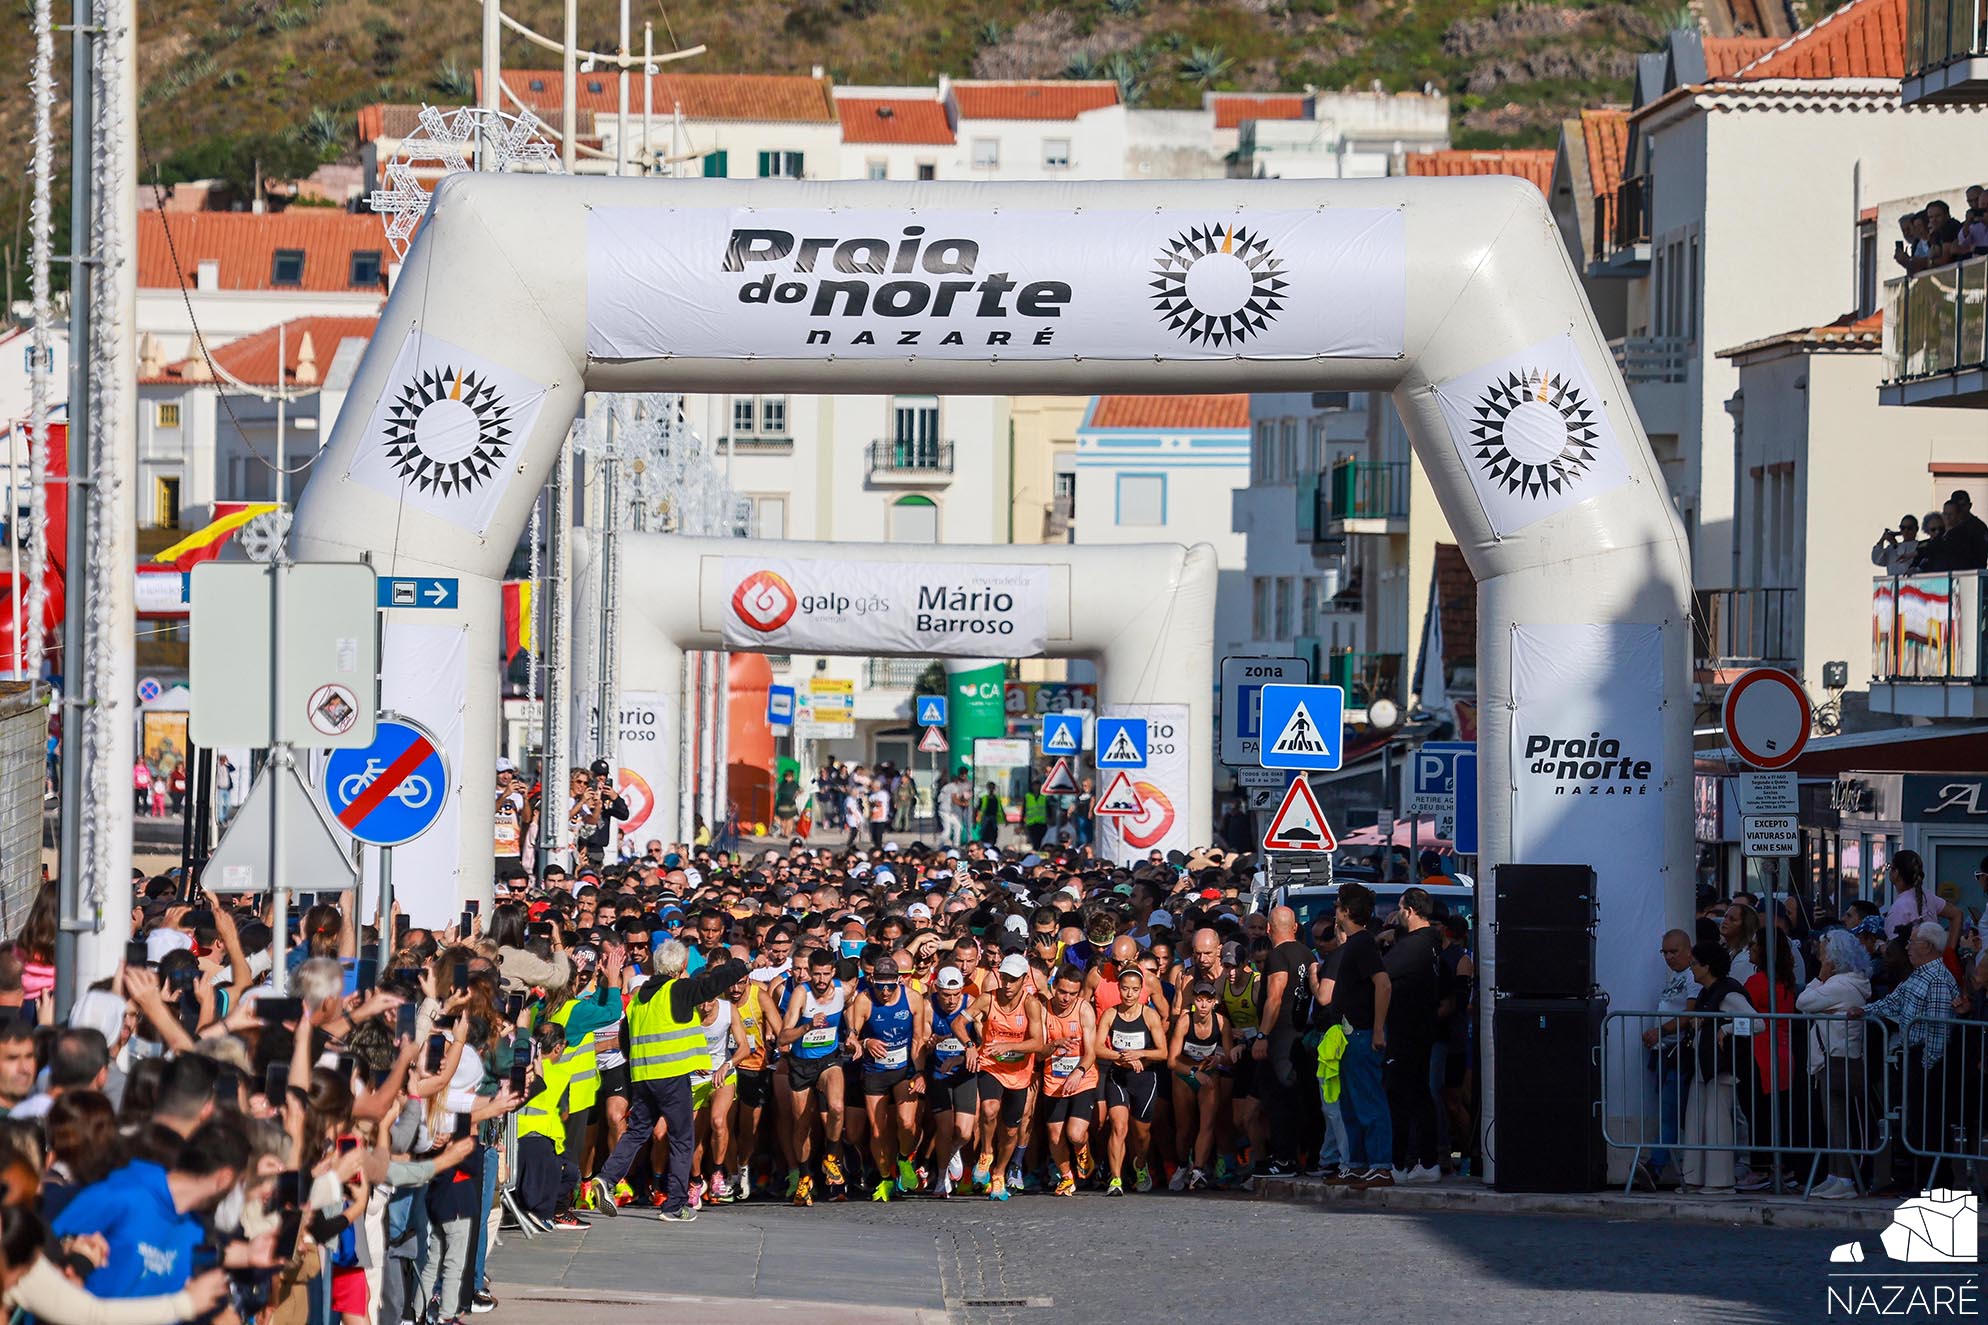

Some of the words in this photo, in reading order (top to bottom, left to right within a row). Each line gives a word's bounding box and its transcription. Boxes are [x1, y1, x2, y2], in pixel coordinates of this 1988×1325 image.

[721, 225, 980, 276] Praia
[738, 273, 808, 305] do
[810, 272, 1073, 318] norte
[802, 592, 849, 615] galp
[855, 594, 889, 616] gás
[917, 585, 1014, 612] Mário
[916, 613, 1014, 635] Barroso
[1245, 666, 1283, 678] zona
[980, 683, 1000, 698] CA
[1525, 731, 1620, 758] Praia
[1420, 755, 1445, 791] P
[1530, 758, 1555, 774] do
[1556, 756, 1651, 780] norte
[1747, 831, 1785, 840] VIATURAS
[1786, 832, 1797, 840] DA
[1754, 820, 1789, 828] EXCEPTO
[1752, 843, 1768, 852] CMN
[1770, 844, 1775, 852] E
[1776, 844, 1793, 852] SMN
